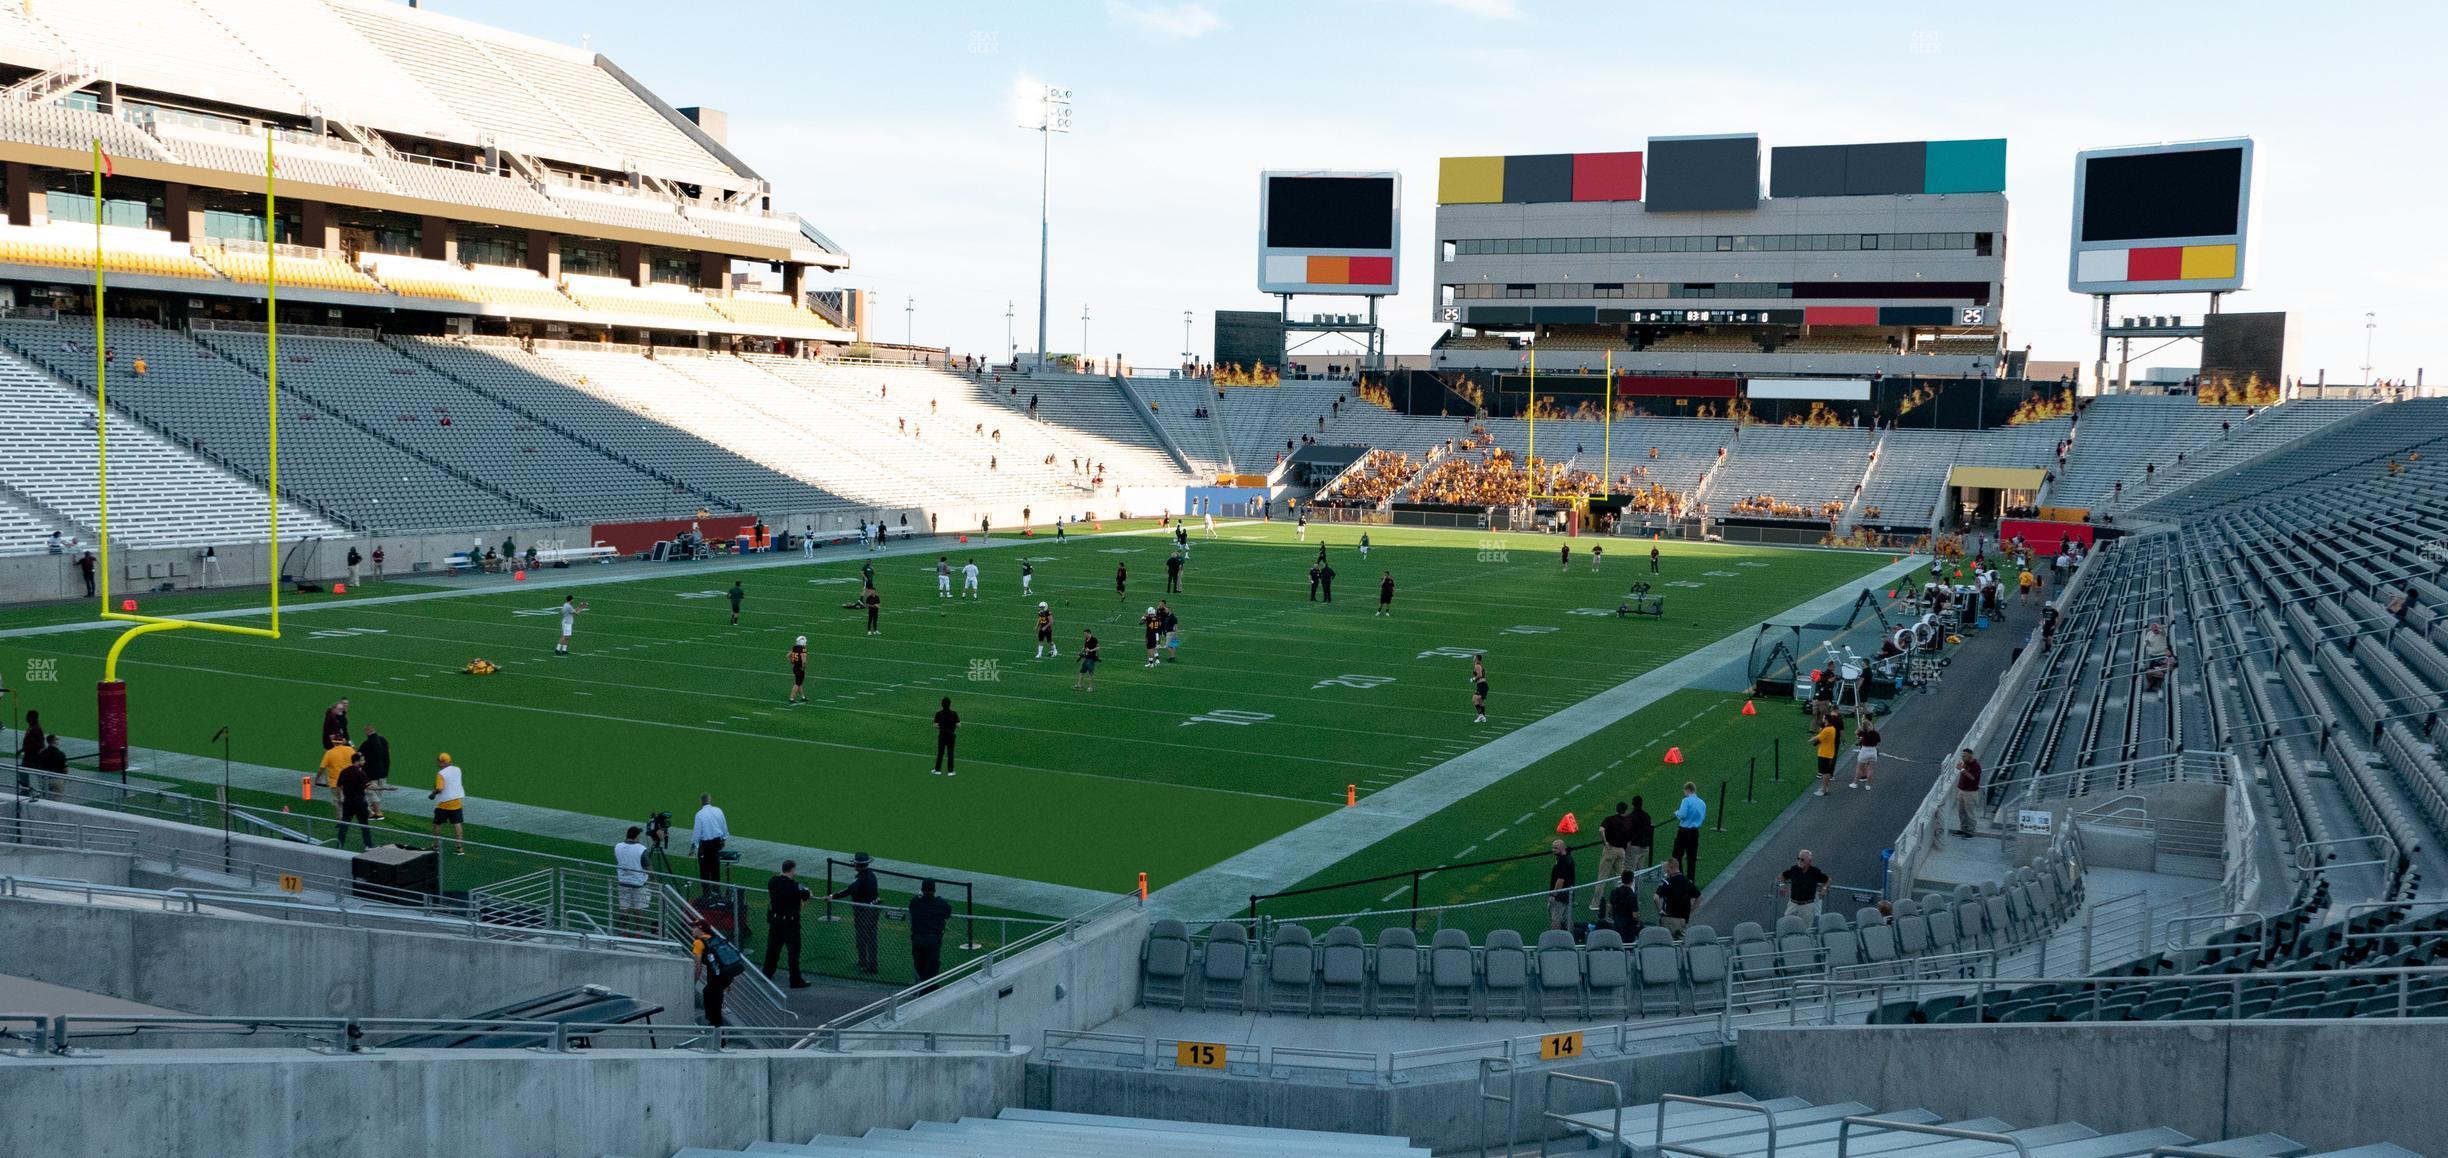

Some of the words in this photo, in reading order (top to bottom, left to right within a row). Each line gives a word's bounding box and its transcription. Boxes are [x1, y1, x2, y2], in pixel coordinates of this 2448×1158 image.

[1444, 308, 1459, 320] 25
[1963, 309, 1981, 323] 25
[1317, 674, 1397, 689] 20
[1189, 709, 1276, 726] 10
[285, 877, 297, 890] 17
[1552, 1036, 1573, 1056] 14
[1190, 1045, 1215, 1065] 15
